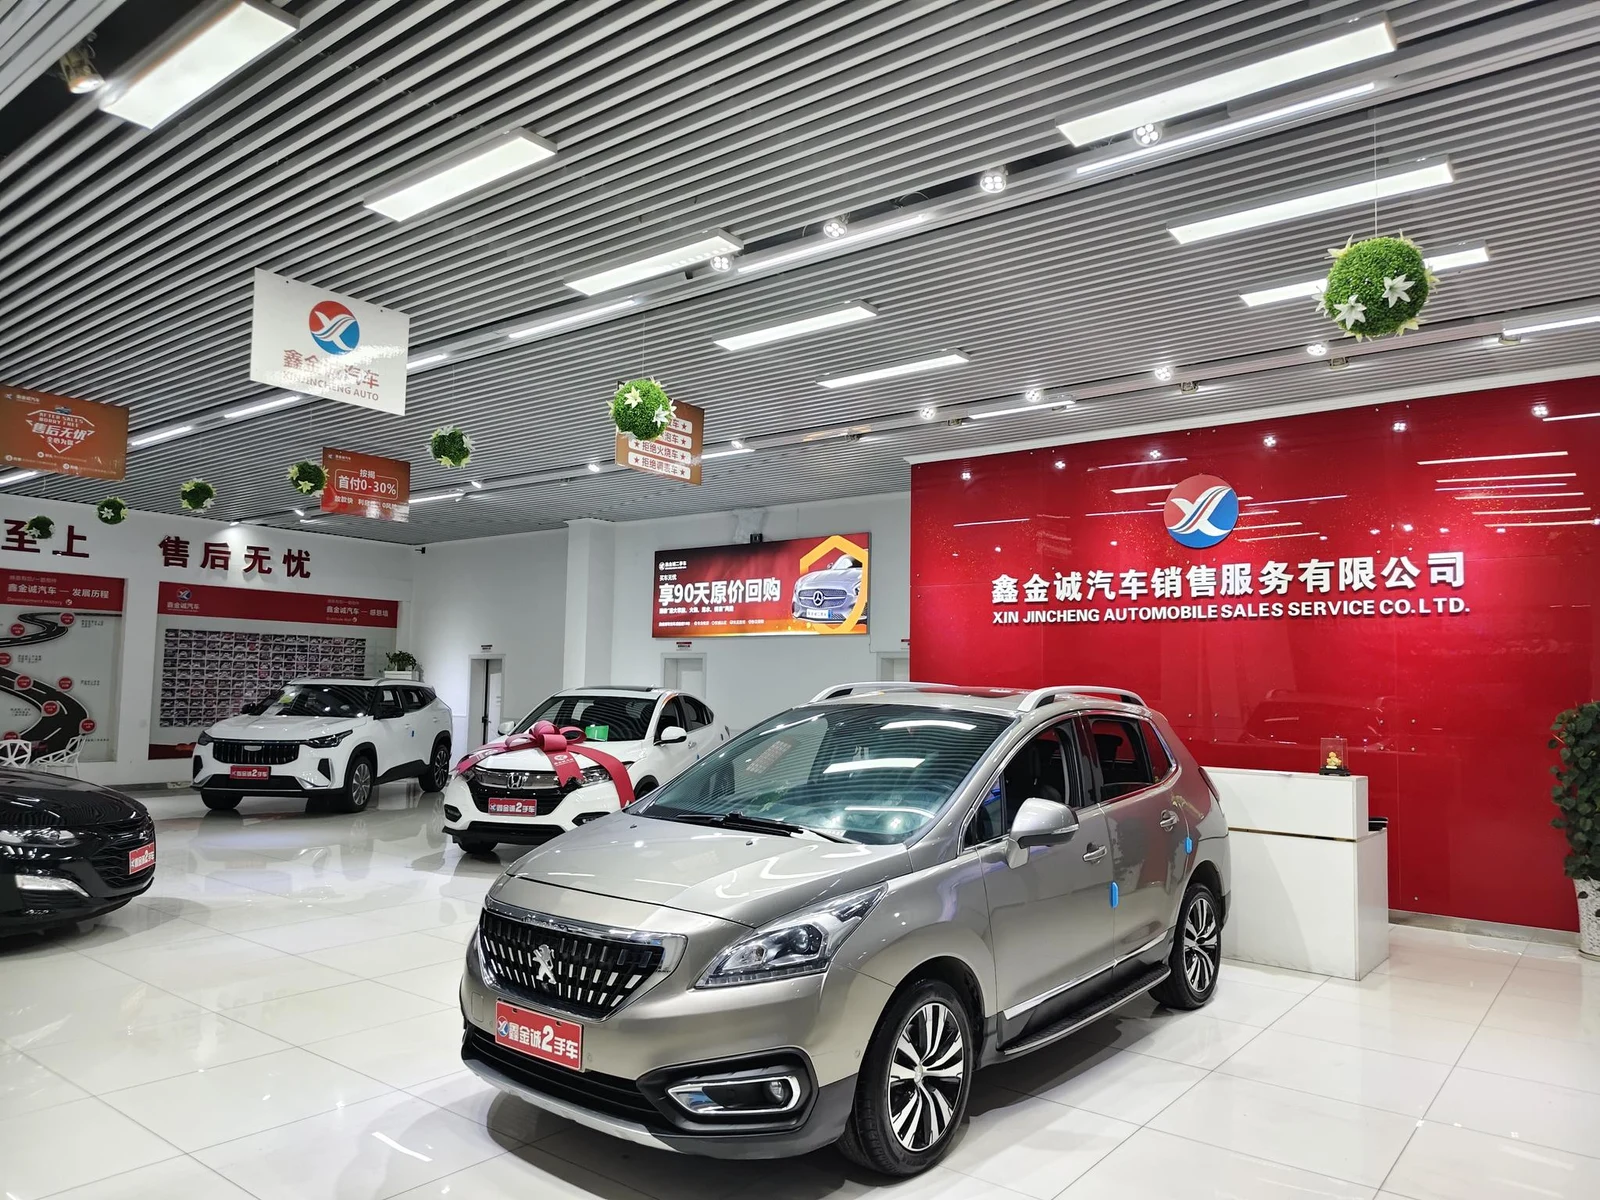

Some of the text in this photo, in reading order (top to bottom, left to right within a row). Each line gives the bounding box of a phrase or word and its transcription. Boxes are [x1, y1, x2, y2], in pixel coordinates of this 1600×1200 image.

[283, 349, 380, 389] 鑫金汽车
[354, 388, 379, 401] AUTO
[642, 441, 679, 460] 拒绝火烧车
[338, 475, 396, 495] 首付0-30%
[2, 519, 89, 558] 至上
[158, 536, 311, 578] 售后无忧
[658, 577, 781, 606] 享90天原价回购
[992, 552, 1464, 604] 鑫金诚汽车销售服务有限公司
[992, 611, 1019, 624] XIN
[1023, 608, 1100, 623] JINCHENG
[1104, 604, 1218, 622] AUTOMOBILE
[1220, 602, 1284, 618] SALES
[1288, 600, 1375, 616] SERVICE
[508, 1022, 578, 1059] 鑫金诚2手车
